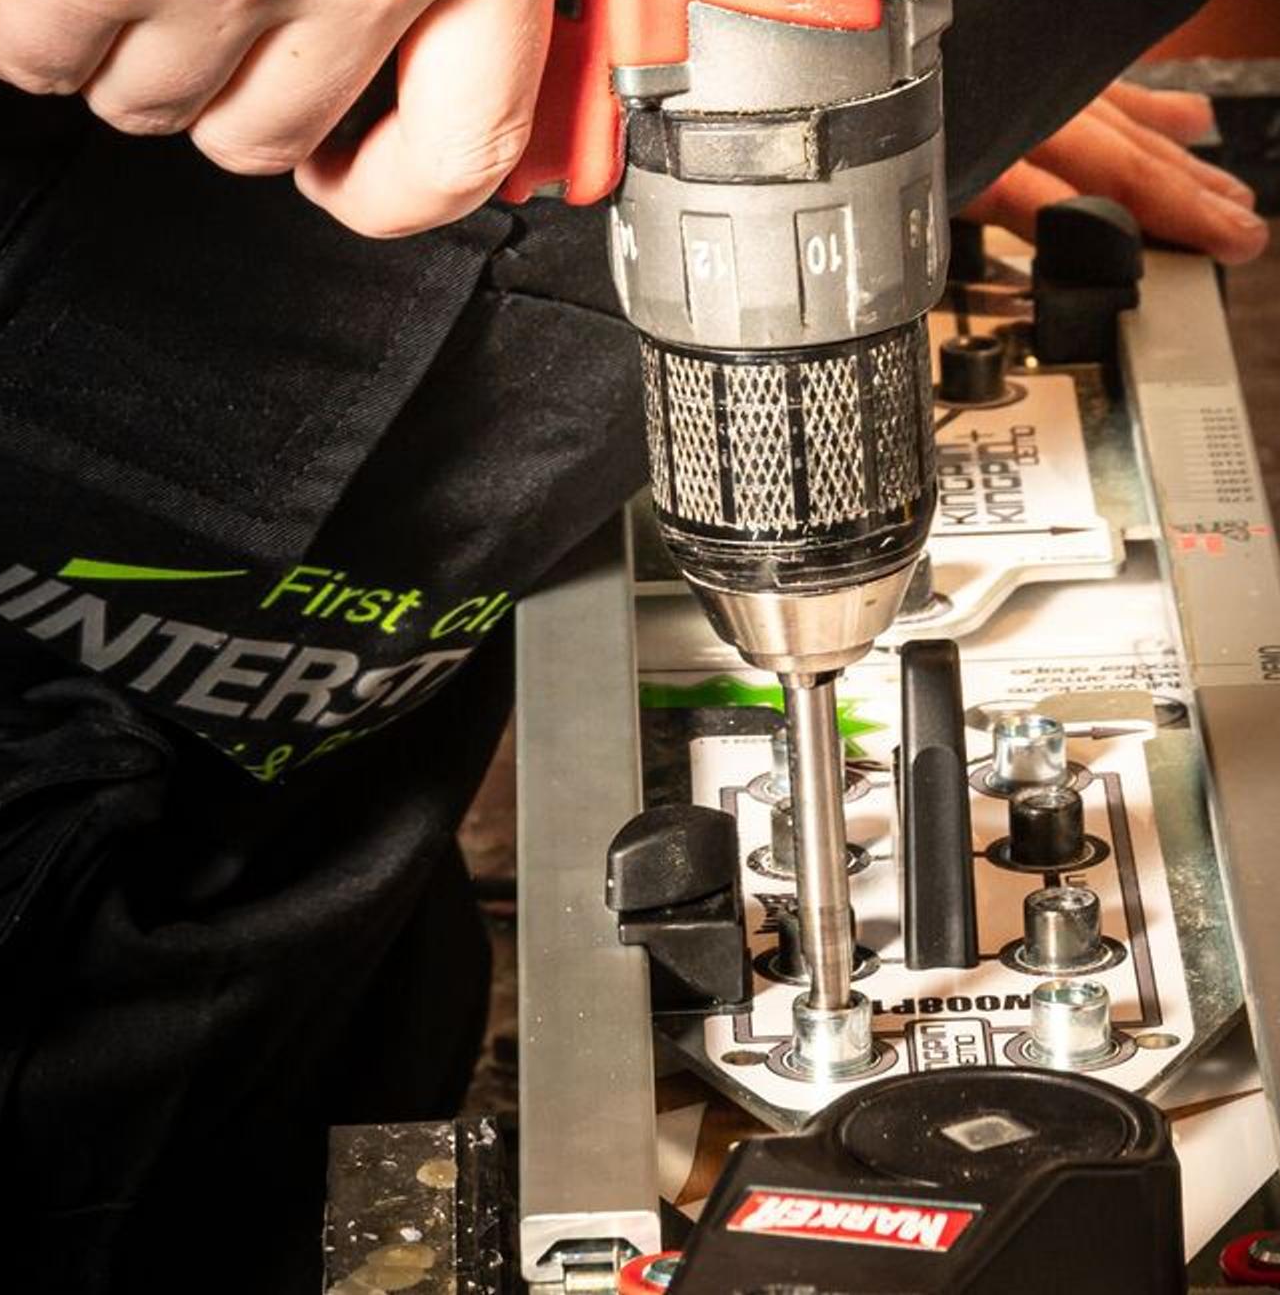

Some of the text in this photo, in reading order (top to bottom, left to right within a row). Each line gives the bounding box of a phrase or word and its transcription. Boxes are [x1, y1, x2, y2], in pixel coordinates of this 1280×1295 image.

[691, 237, 727, 279] 12
[806, 233, 841, 276] 10
[978, 442, 1026, 524] KINGPIN
[261, 566, 422, 633] First
[741, 1196, 948, 1249] MARKER
